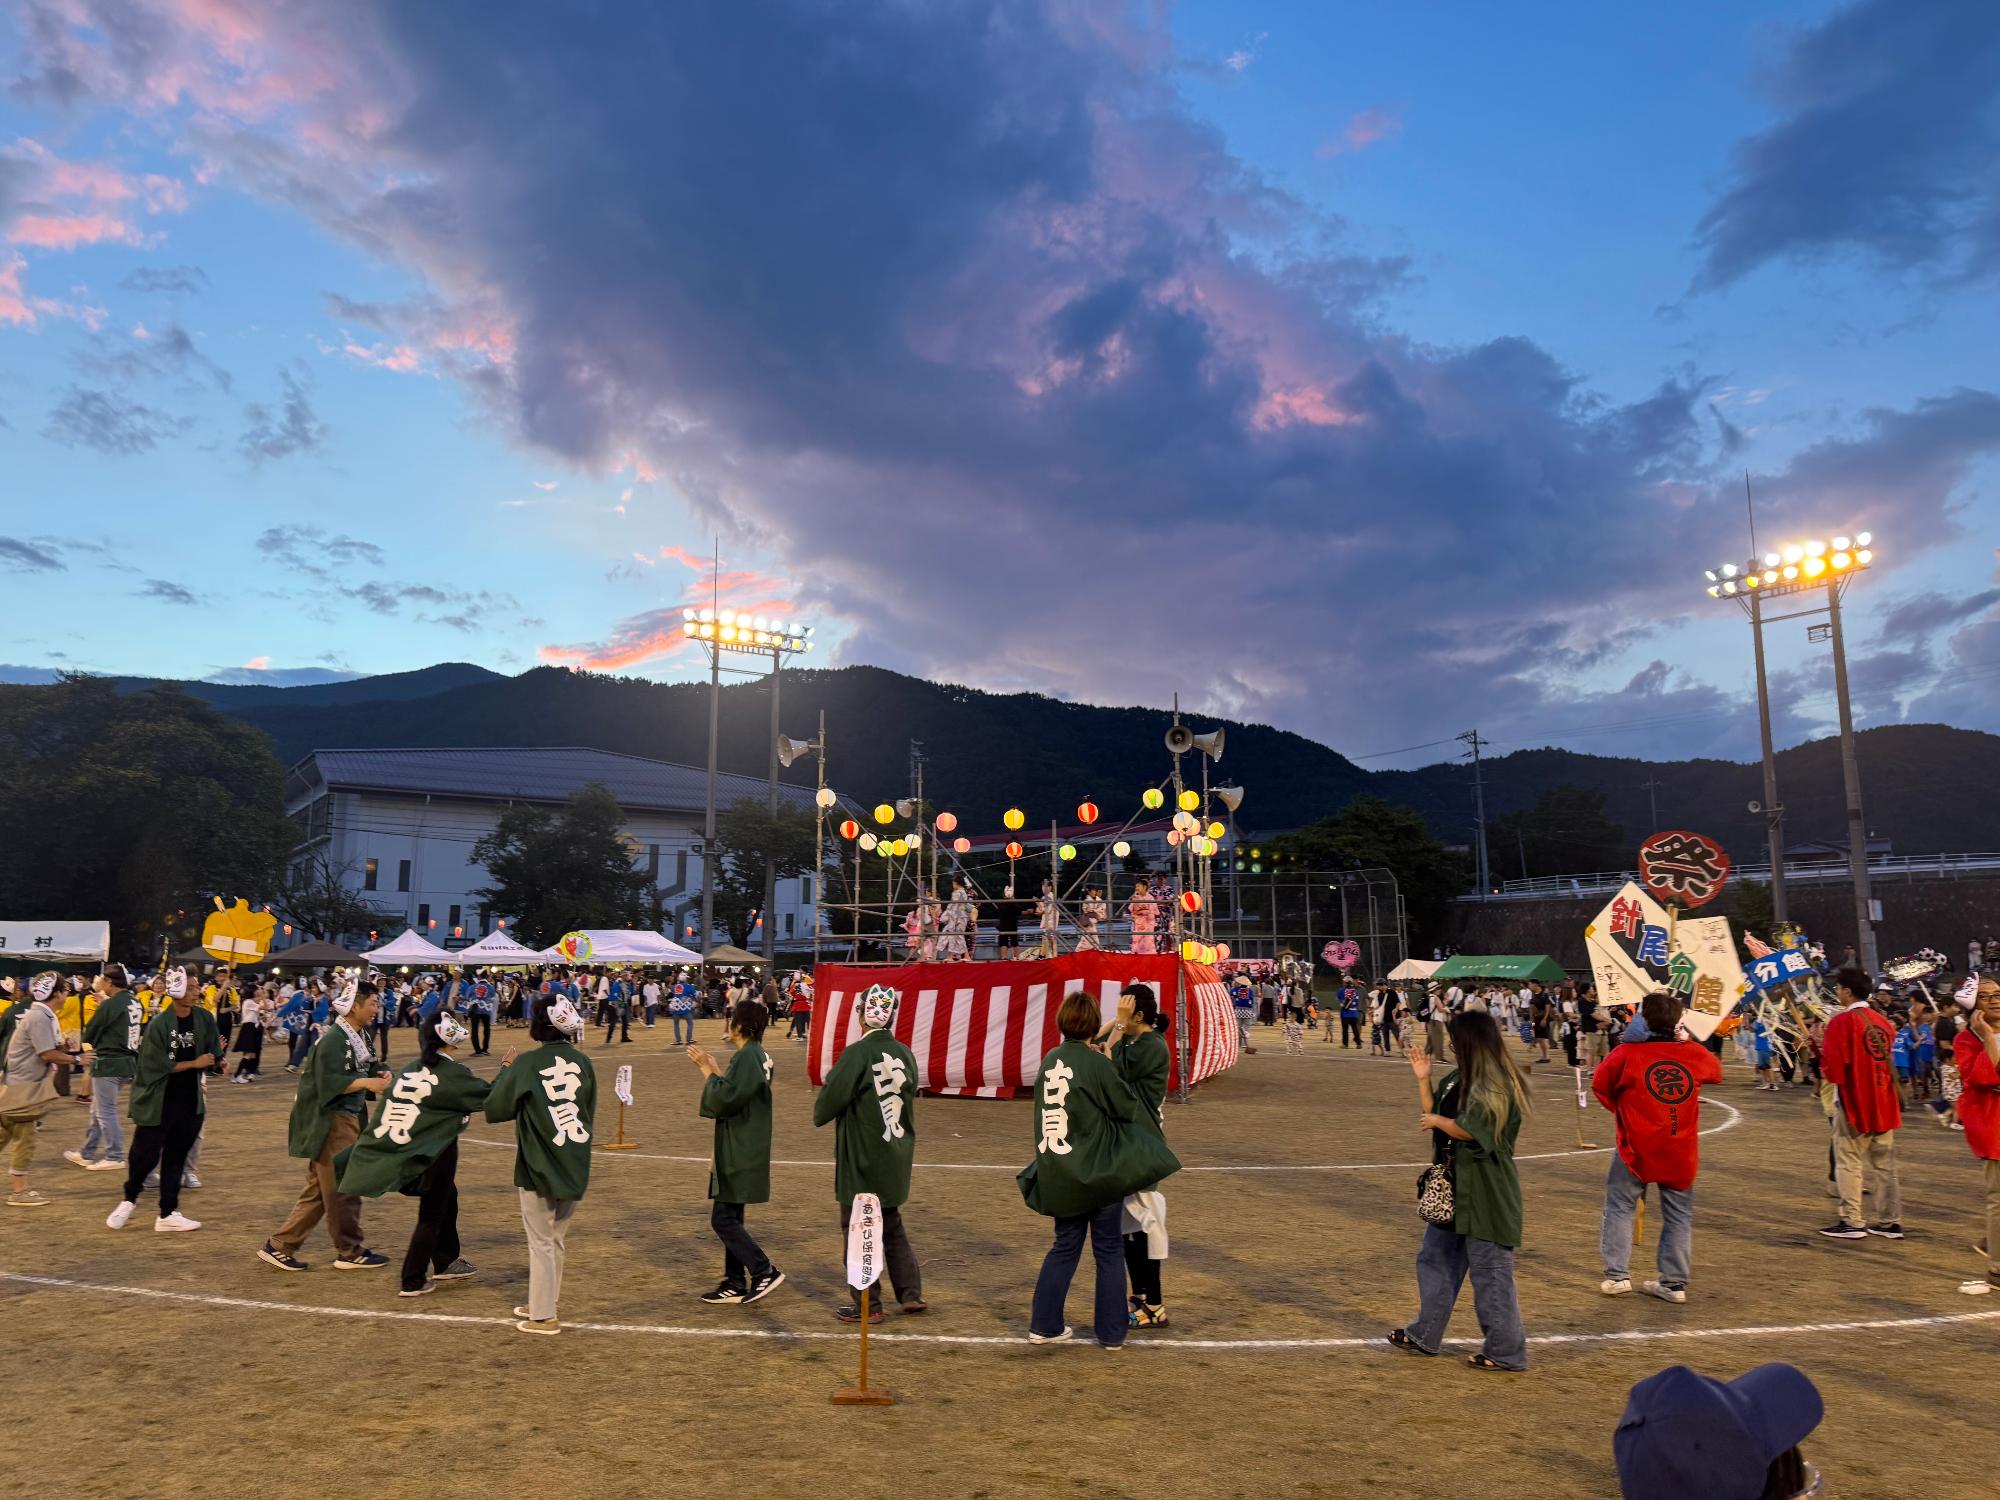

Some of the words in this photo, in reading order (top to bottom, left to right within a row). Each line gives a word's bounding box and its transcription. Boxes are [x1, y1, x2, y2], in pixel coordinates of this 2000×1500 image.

[1641, 833, 1726, 899] 祭
[374, 1067, 438, 1143] 古見
[540, 1056, 591, 1147] 古見
[872, 1053, 906, 1142] 古見
[1038, 1060, 1073, 1155] 古見
